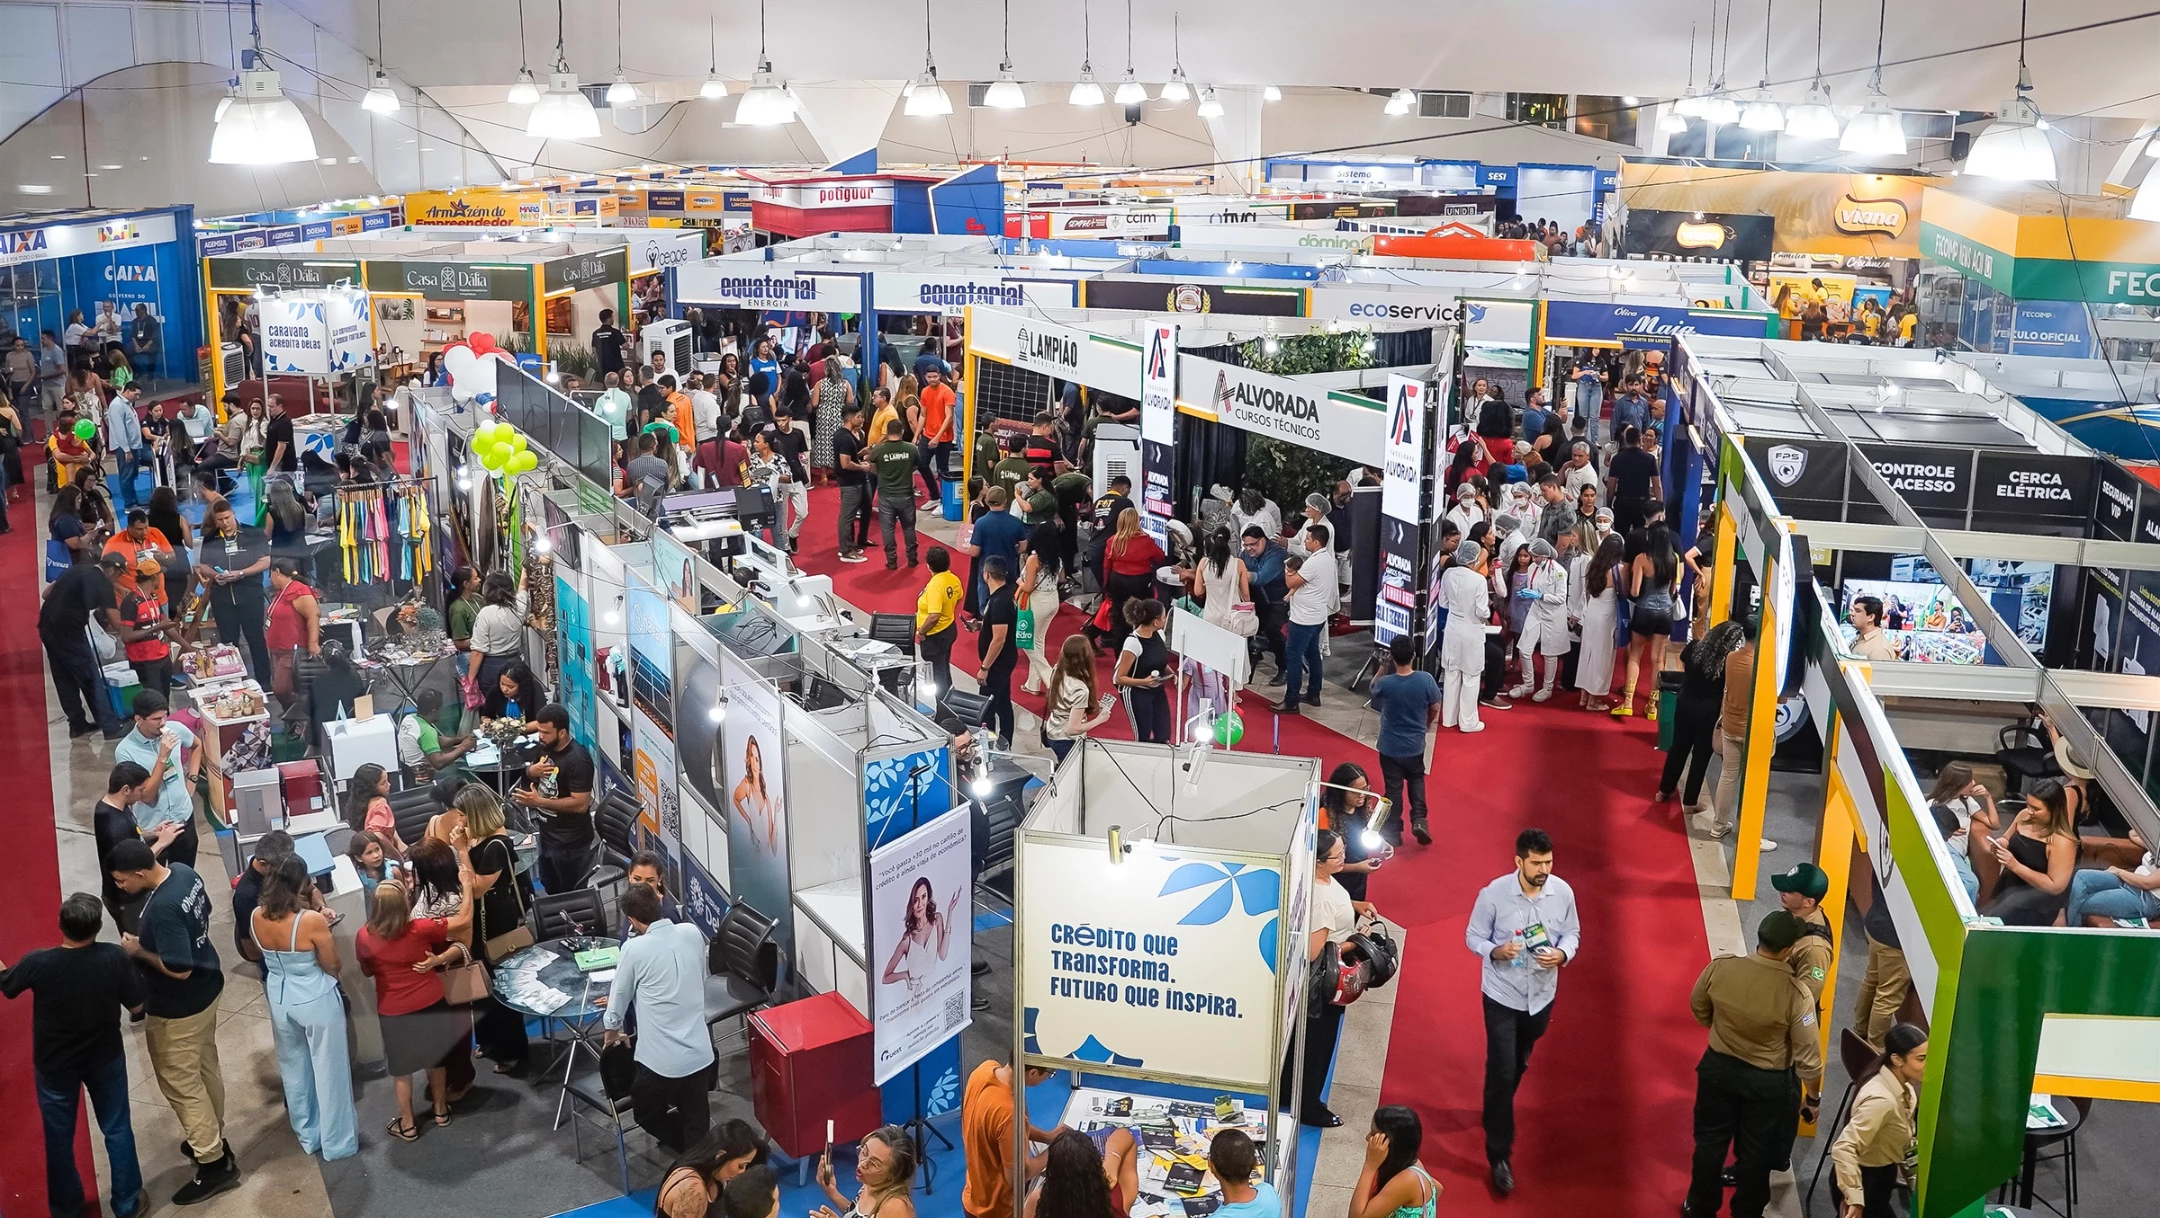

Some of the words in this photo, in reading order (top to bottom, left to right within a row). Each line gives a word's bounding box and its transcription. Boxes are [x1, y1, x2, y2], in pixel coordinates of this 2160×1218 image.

[1488, 172, 1507, 181] SESI
[820, 187, 874, 203] potiguar
[490, 206, 506, 218] do
[0, 230, 48, 255] AIXA
[104, 265, 157, 282] CAIXA
[246, 267, 275, 282] Casa
[293, 268, 320, 282] Dália
[407, 270, 438, 286] Casa
[458, 272, 488, 288] Dália
[563, 268, 581, 282] Casa
[590, 261, 606, 275] Dália
[720, 275, 816, 300] equatorial
[920, 281, 1024, 306] equatorial
[2108, 271, 2160, 298] FEC
[748, 300, 790, 308] ENERGIA
[1350, 302, 1464, 323] ecoservice
[1624, 316, 1697, 336] Maia
[2040, 332, 2081, 342] OFICIAL
[1030, 334, 1078, 368] LAMPIÃO
[1234, 382, 1320, 424] ALVORADA
[1235, 408, 1272, 428] CURSOS
[1274, 415, 1321, 442] TÉCNICOS
[1776, 452, 1800, 460] FPS
[1872, 462, 1956, 479] CONTROLE
[2008, 470, 2062, 486] CERCA
[1893, 476, 1956, 494] ACESSO
[1996, 482, 2072, 501] ELÉTRICA
[2102, 480, 2134, 512] SEGURANÇA
[2111, 502, 2122, 519] VIP
[705, 904, 720, 934] Del
[1050, 976, 1119, 1003] FUTURO
